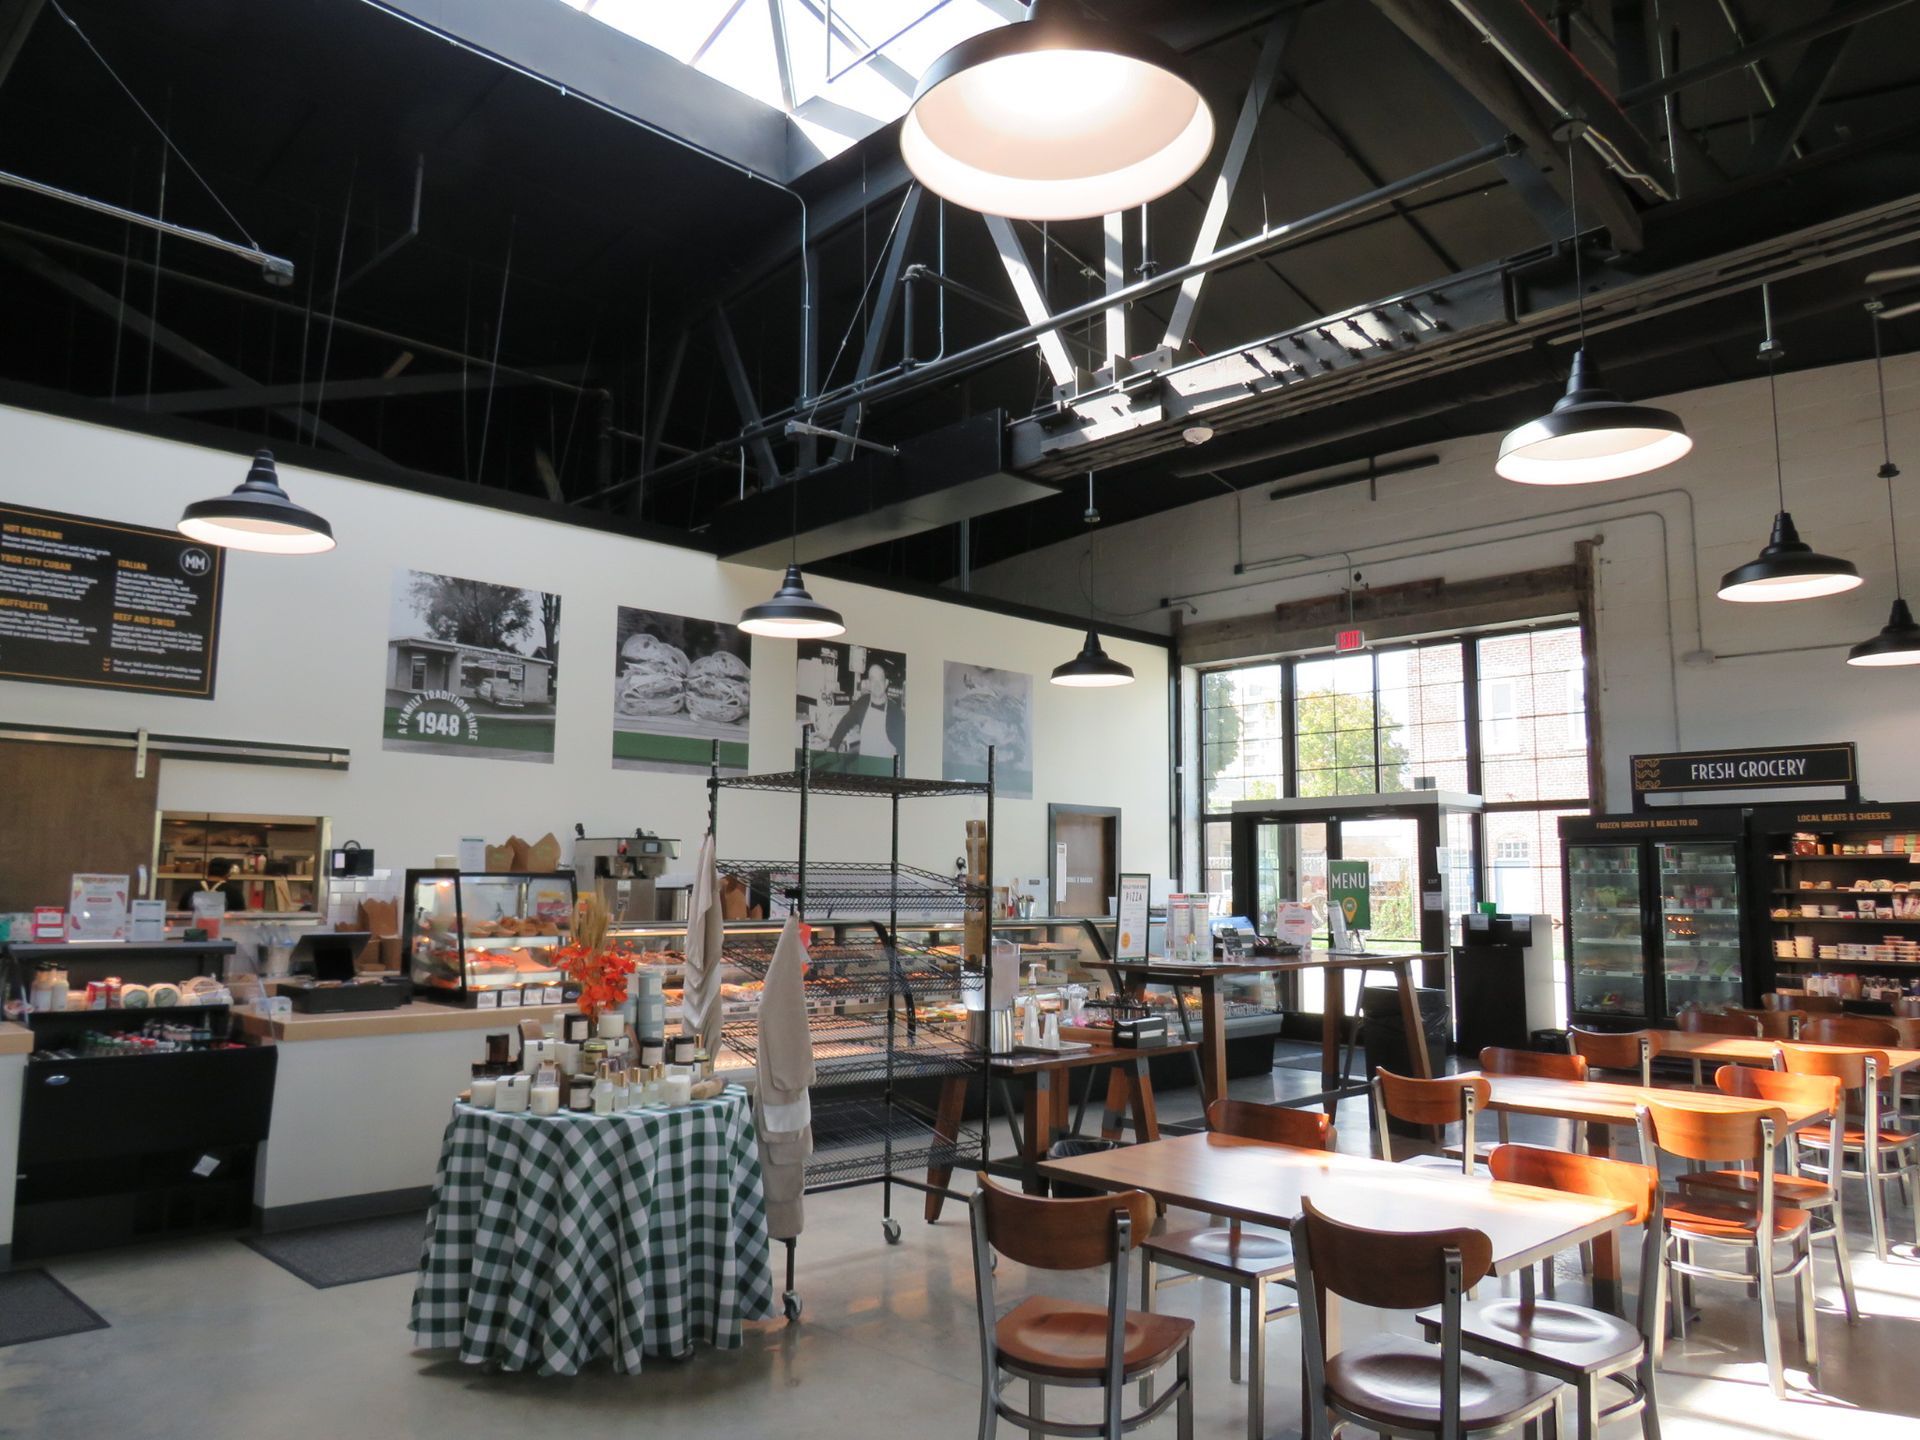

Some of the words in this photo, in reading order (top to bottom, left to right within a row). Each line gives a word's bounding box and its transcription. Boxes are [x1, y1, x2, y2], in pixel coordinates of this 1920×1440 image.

[21, 526, 63, 540] PASTRAMI
[24, 557, 40, 566] CITY
[43, 560, 72, 571] CUBAN
[118, 560, 148, 571] ITALIAN
[185, 554, 205, 570] MM
[113, 612, 132, 622] BEEF
[133, 615, 151, 624] AND
[151, 617, 176, 628] SWISS
[398, 695, 423, 726] FAMILY
[423, 689, 470, 713] TRADITION
[466, 712, 478, 741] SINCE
[416, 712, 460, 737] 1948
[1691, 762, 1735, 780] FRESH
[1739, 759, 1806, 778] GROCERY
[1596, 822, 1620, 830] FROZEN
[1621, 821, 1649, 829] GROCERY
[1656, 820, 1678, 828] MEALS
[1679, 819, 1687, 827] TO
[1797, 814, 1820, 822] LOCAL
[1822, 813, 1847, 822] MEATS
[1856, 812, 1891, 820] CHEESES
[1332, 872, 1366, 889] MENU
[1125, 890, 1143, 902] PIZZA
